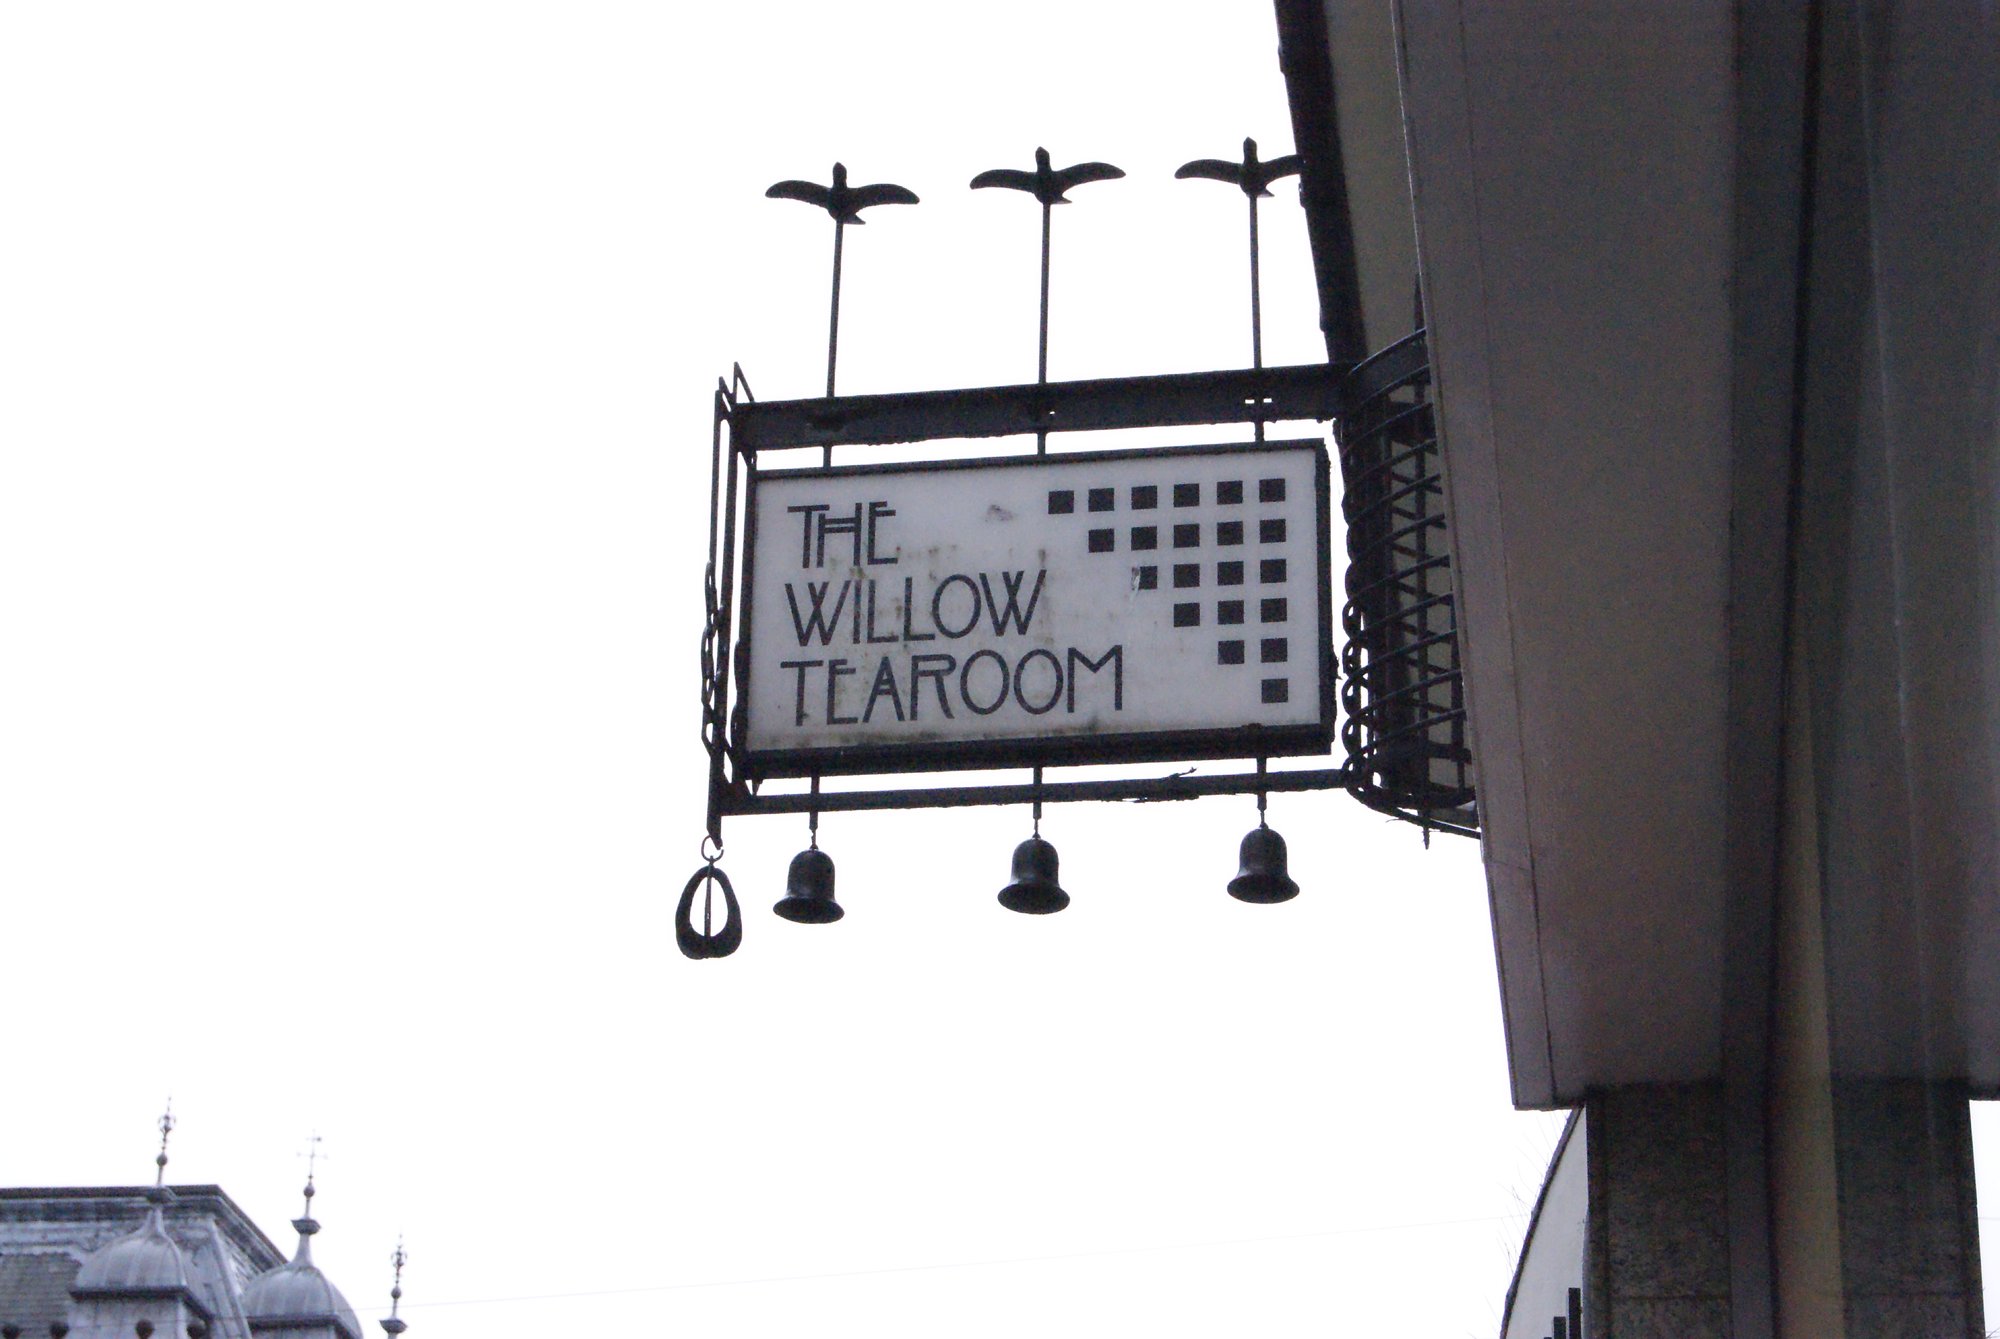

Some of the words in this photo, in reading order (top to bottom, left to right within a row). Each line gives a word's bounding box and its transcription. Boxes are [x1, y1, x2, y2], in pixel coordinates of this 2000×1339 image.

[786, 500, 899, 569] THE
[784, 568, 1048, 648] WILLOW
[779, 644, 1124, 728] TEAROOM
